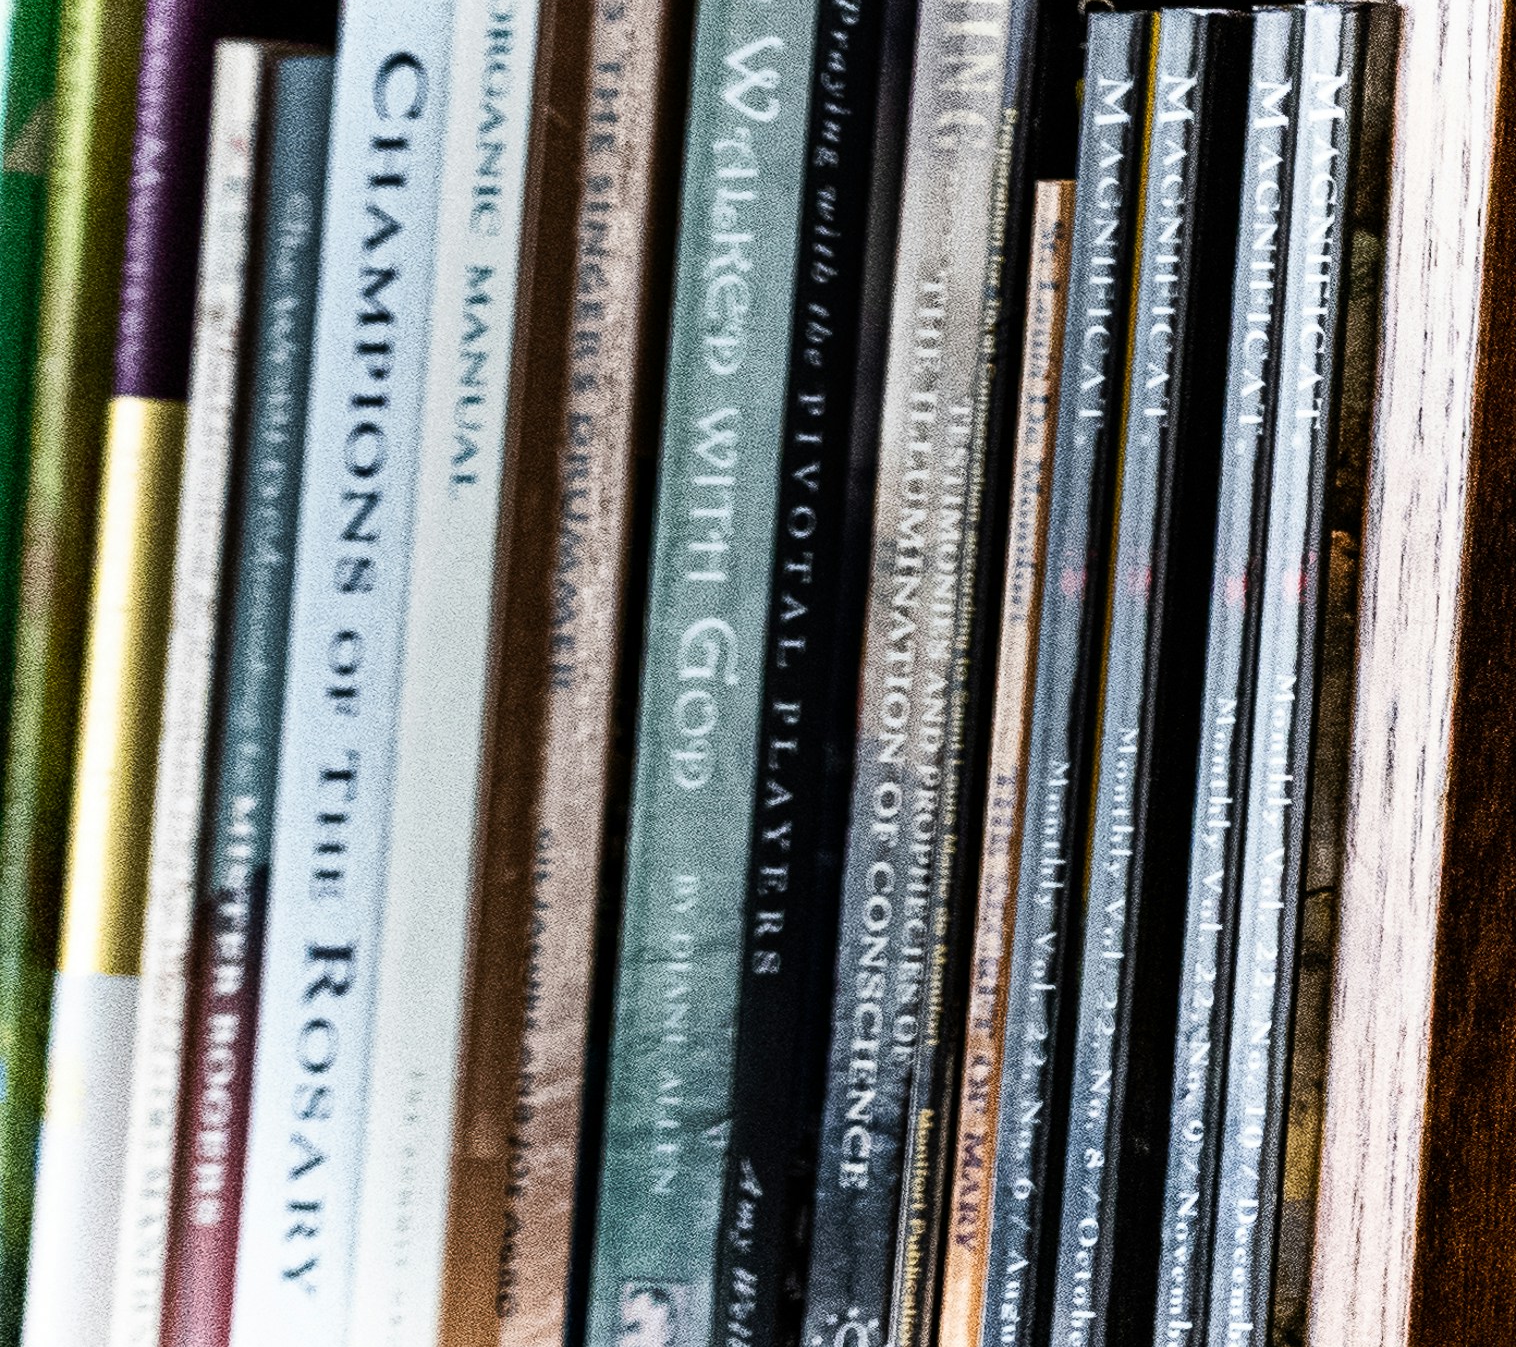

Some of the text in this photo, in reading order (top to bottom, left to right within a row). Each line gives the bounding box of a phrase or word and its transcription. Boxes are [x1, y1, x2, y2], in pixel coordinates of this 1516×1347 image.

[589, 58, 625, 155] THE
[810, 185, 845, 287] with
[986, 105, 1018, 264] Preparation
[985, 267, 1004, 293] for
[1076, 74, 1133, 429] MAGNIFICAT
[1142, 73, 1197, 429] MAGNIFICAT
[1237, 75, 1292, 435] MAGNIFICAT
[1293, 65, 1350, 430] MAGNIFICAT
[333, 48, 432, 596] CHAMPIONS
[802, 300, 835, 370] the
[447, 262, 496, 505] MANUAL
[545, 413, 596, 691] DRUMMER
[776, 390, 827, 670] PIVOTAL
[926, 396, 973, 660] TESTIMONIES
[918, 670, 949, 753] AND
[947, 688, 969, 752] Saint
[953, 656, 970, 682] to
[837, 276, 948, 1192] THE ILLUMINATION OF CONSCIENCE
[1200, 694, 1241, 851] Monthly
[1261, 673, 1300, 824] Monthly
[309, 746, 362, 904] THE
[750, 699, 803, 978] PLAYERS
[941, 756, 963, 826] Louis
[1033, 759, 1073, 909] Monthly
[1101, 725, 1141, 875] Monthly
[1098, 896, 1128, 971] Vol.
[1196, 867, 1228, 947] Vol.
[1256, 843, 1288, 921] Vol.
[190, 792, 259, 1229] MISTER ROGERS
[952, 765, 1017, 1255] THE SECRET OF MARY
[1028, 929, 1060, 1005] Vol.
[1086, 1066, 1113, 1128] No.
[1183, 1038, 1212, 1108] No.
[1244, 1019, 1272, 1088] No.
[276, 935, 359, 1299] ROSARY
[908, 1107, 935, 1212] Montfort
[1015, 1097, 1044, 1161] No.
[1084, 1145, 1107, 1169] 8
[1182, 1117, 1205, 1142] 9
[1238, 1101, 1263, 1150] 10
[728, 1156, 766, 1253] Amy
[1013, 1176, 1036, 1200] 6
